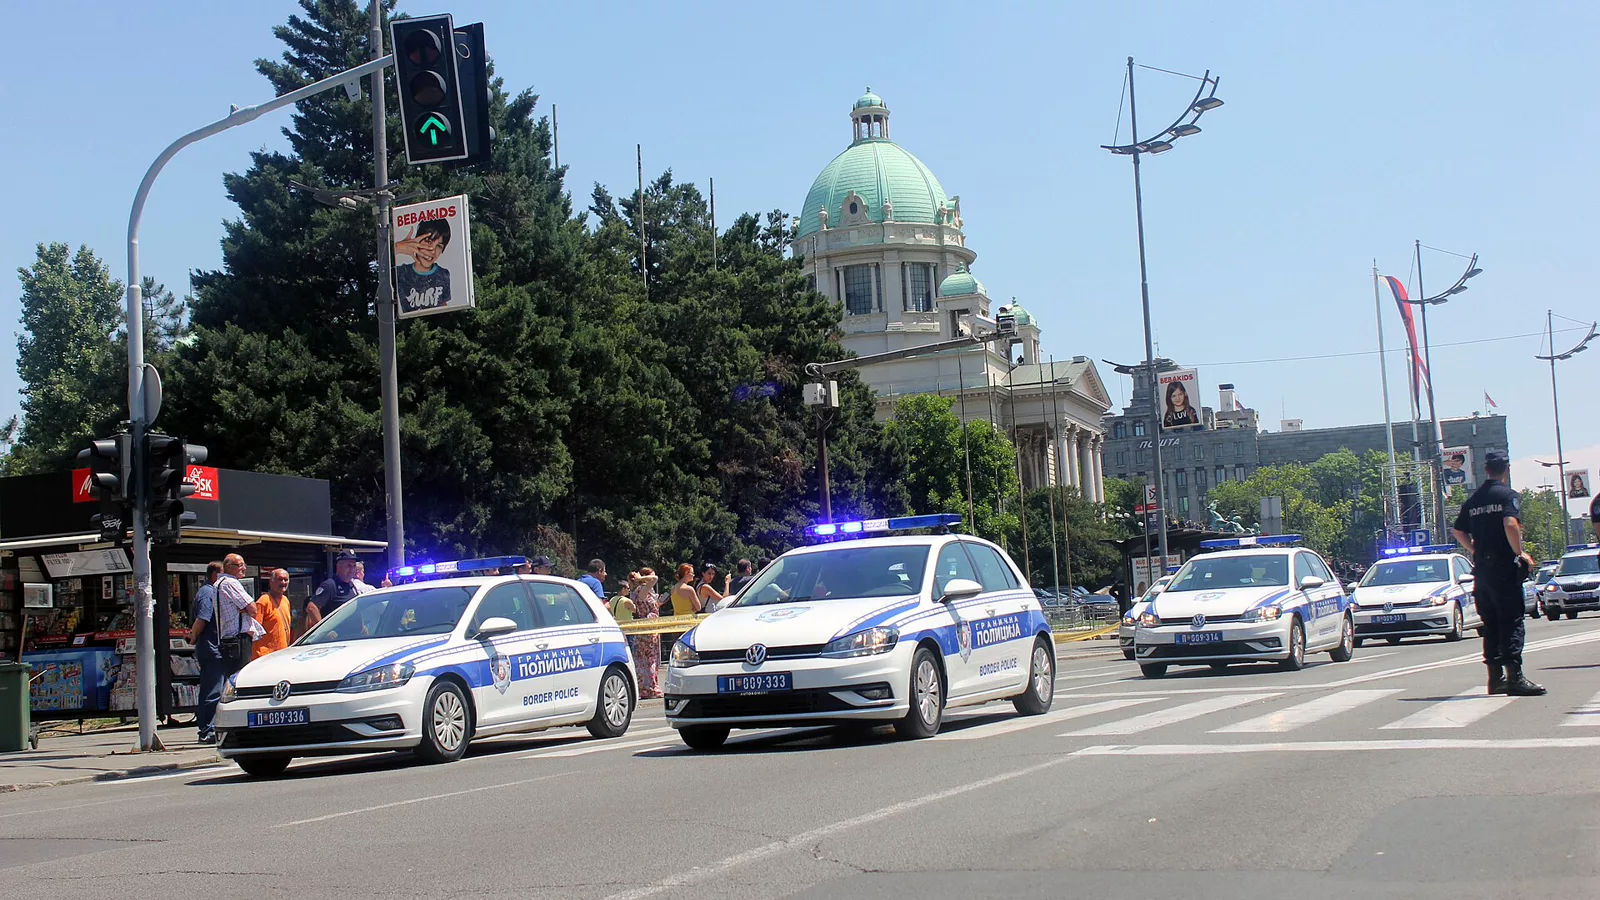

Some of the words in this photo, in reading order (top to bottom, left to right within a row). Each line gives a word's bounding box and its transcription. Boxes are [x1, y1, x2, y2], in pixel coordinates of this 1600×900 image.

[397, 205, 457, 227] BEBAKIDS
[1160, 374, 1194, 384] BEBAKIDS
[1415, 531, 1426, 545] P
[975, 615, 1018, 630] ГРАНИЧНА
[976, 623, 1021, 645] ПОЛИЦИЈА
[518, 648, 580, 663] ГРАНИЧНА
[519, 655, 584, 677] ПОЛИЦИЈА
[980, 662, 1000, 676] BORDER
[1000, 658, 1017, 670] POLICE
[743, 675, 785, 689] 009-333
[523, 692, 553, 706] BORDER
[554, 687, 578, 700] POLICE
[269, 710, 304, 724] 009-336
